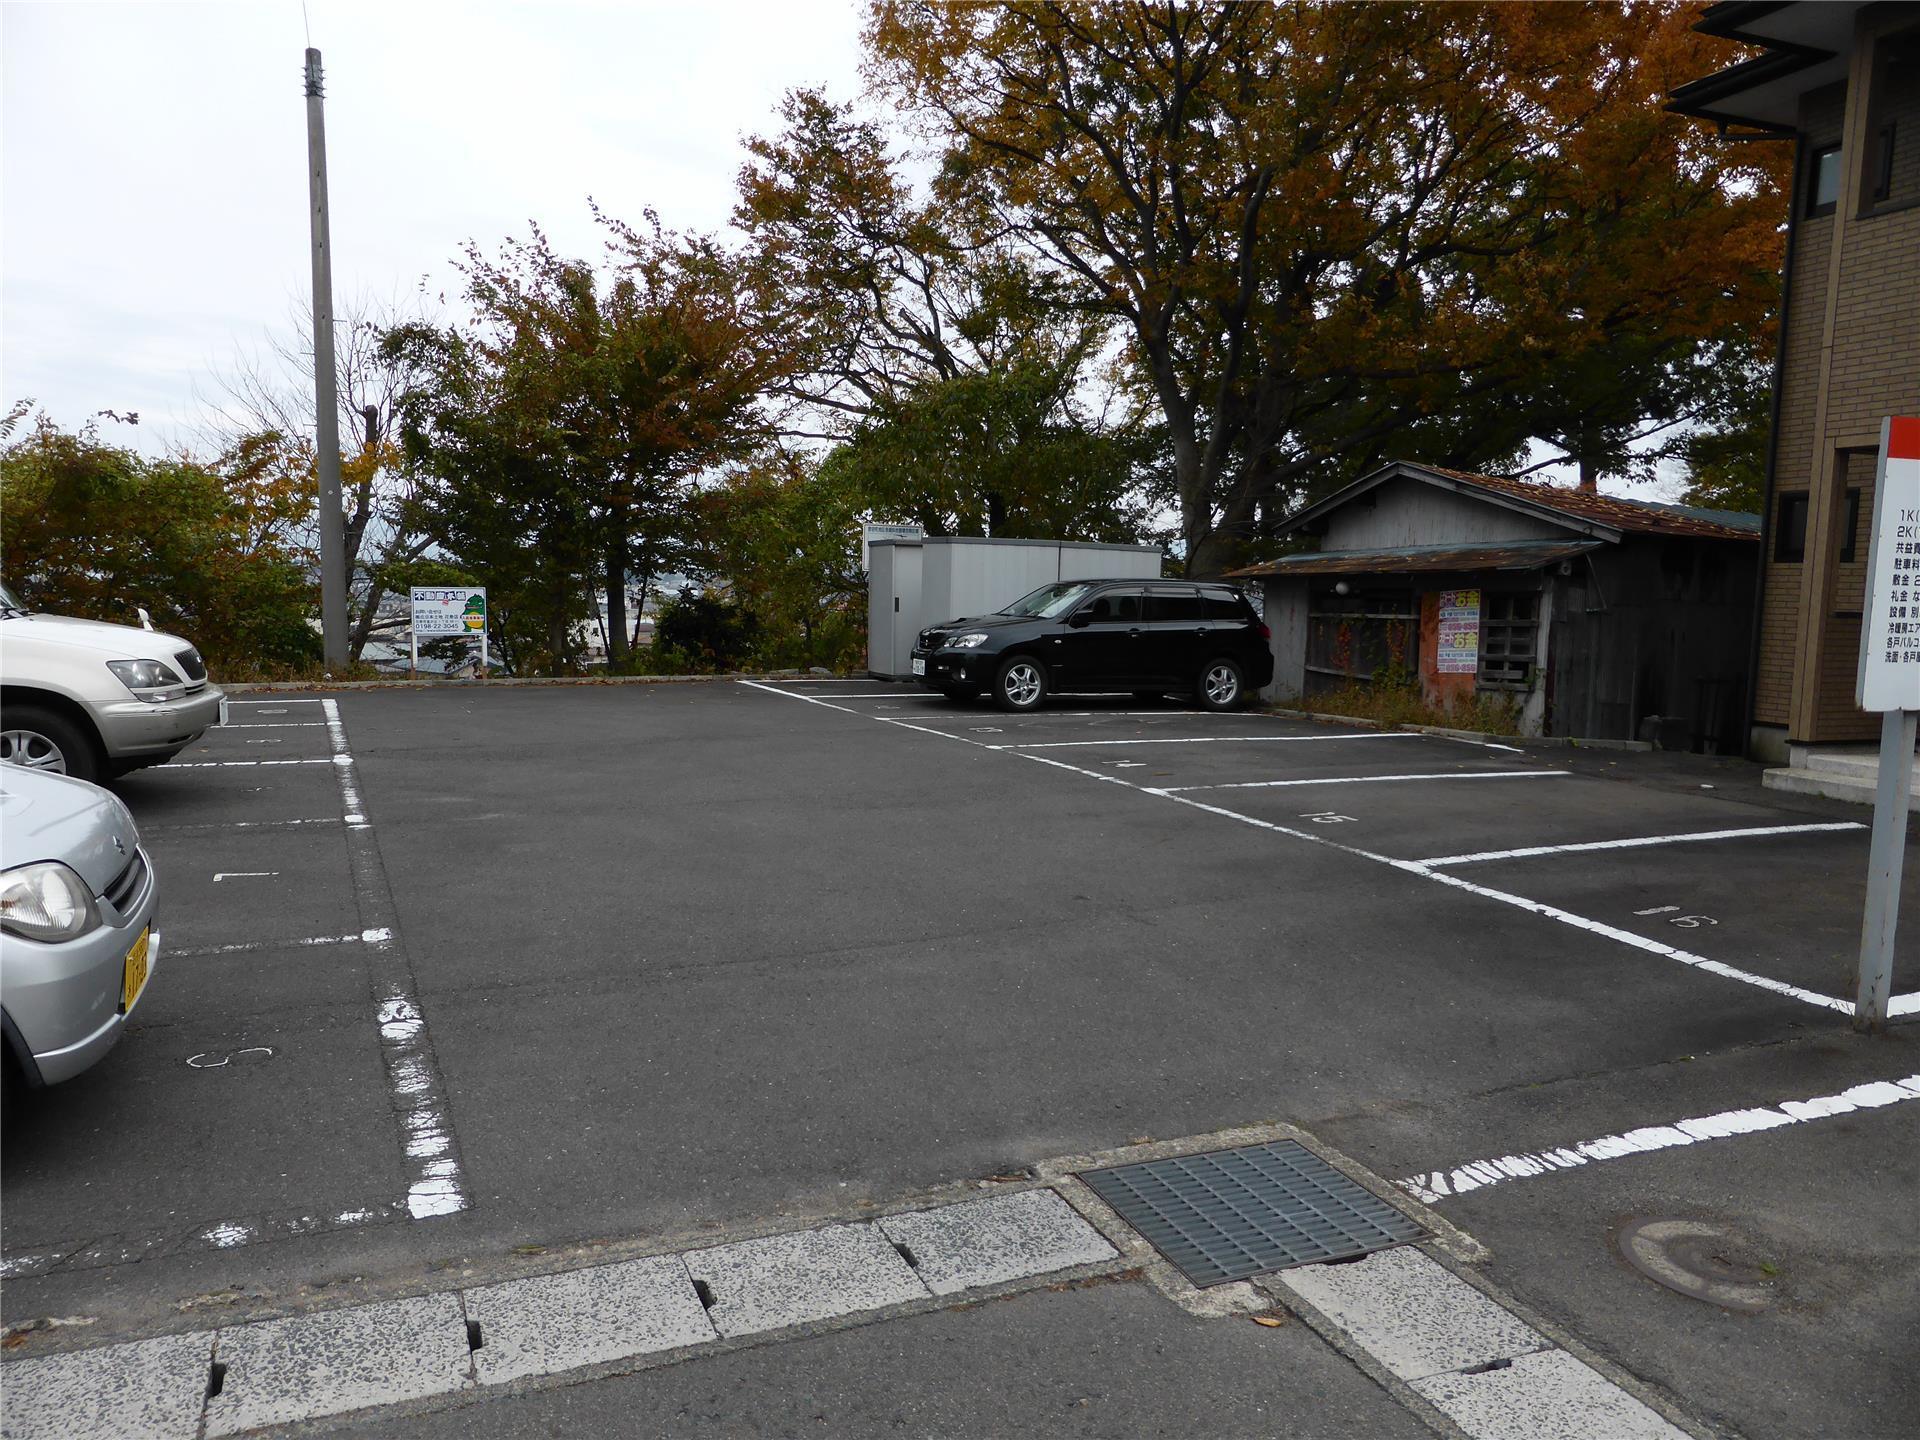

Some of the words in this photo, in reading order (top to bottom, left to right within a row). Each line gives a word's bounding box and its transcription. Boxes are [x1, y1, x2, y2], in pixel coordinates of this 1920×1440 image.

[1897, 526, 1920, 539] 2K(
[1890, 590, 1909, 602] 礼金
[1298, 812, 1359, 823] 15
[1632, 905, 1718, 928] 16
